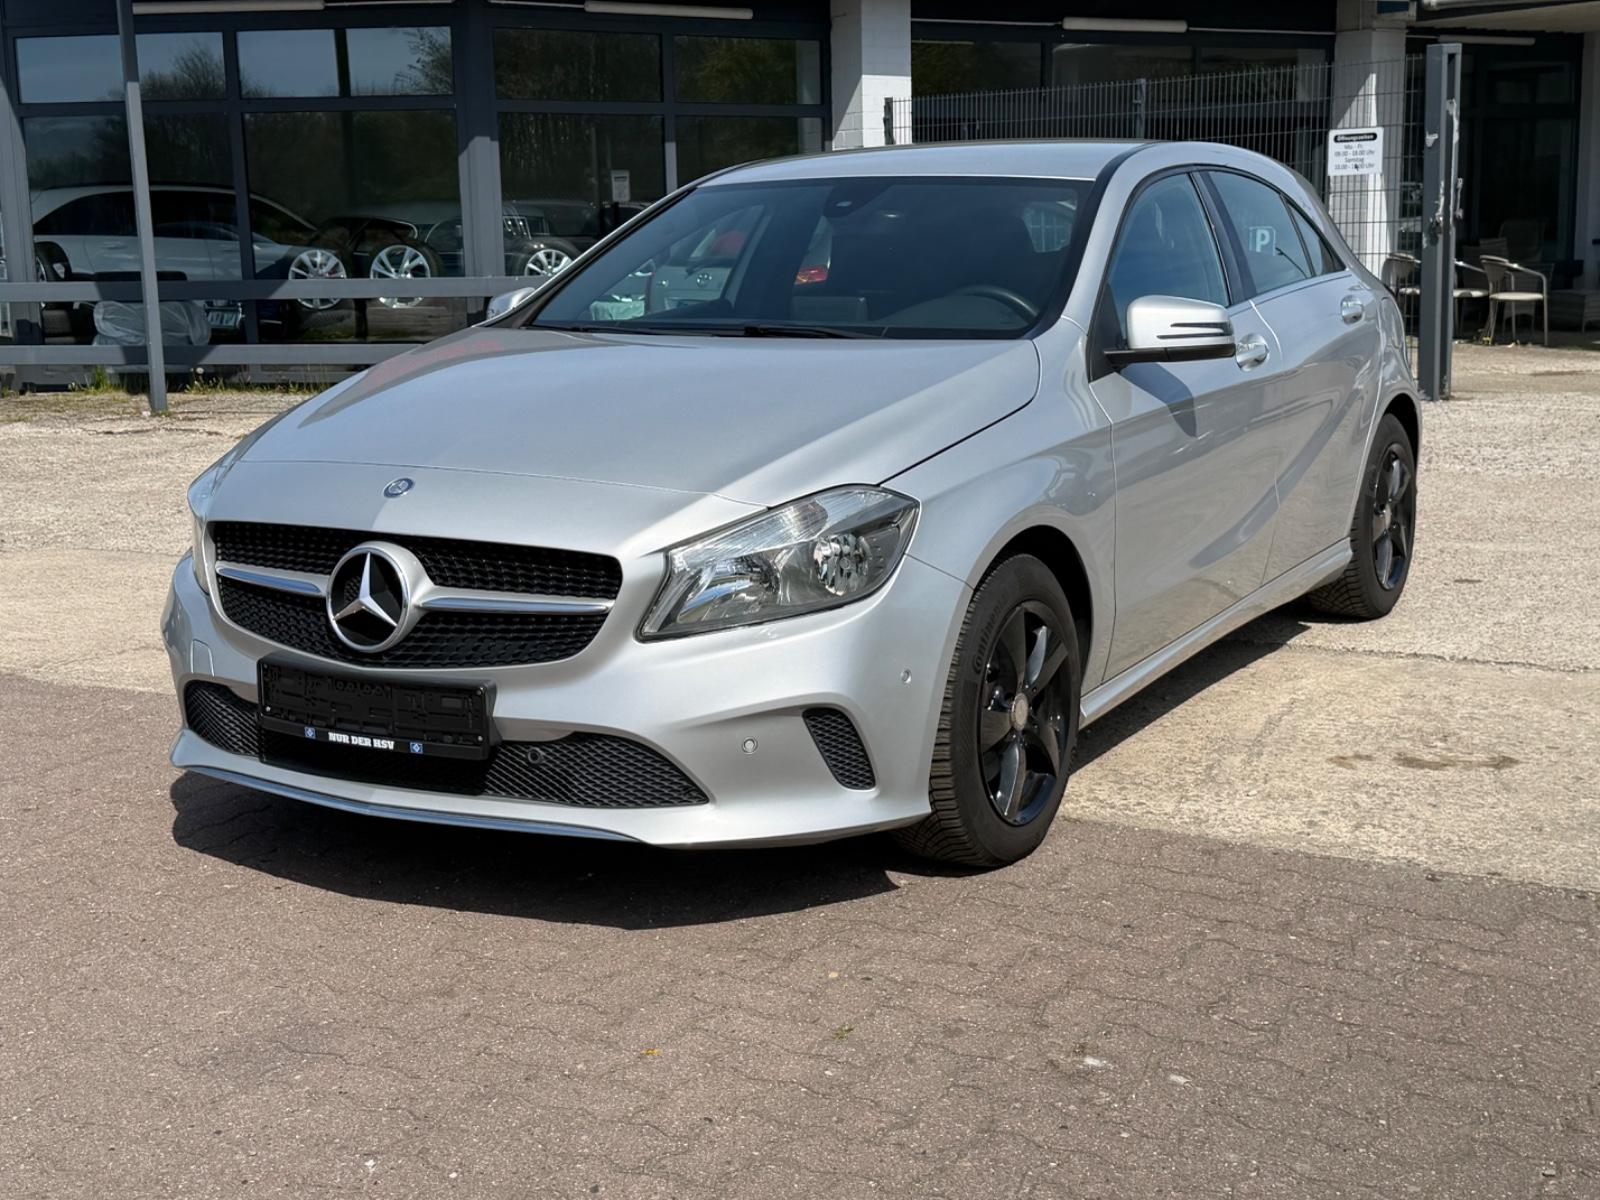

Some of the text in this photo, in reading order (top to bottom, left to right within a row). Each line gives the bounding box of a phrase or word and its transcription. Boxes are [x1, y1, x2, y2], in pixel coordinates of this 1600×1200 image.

[1256, 230, 1270, 252] P
[328, 732, 395, 750] NUR DER HSV
